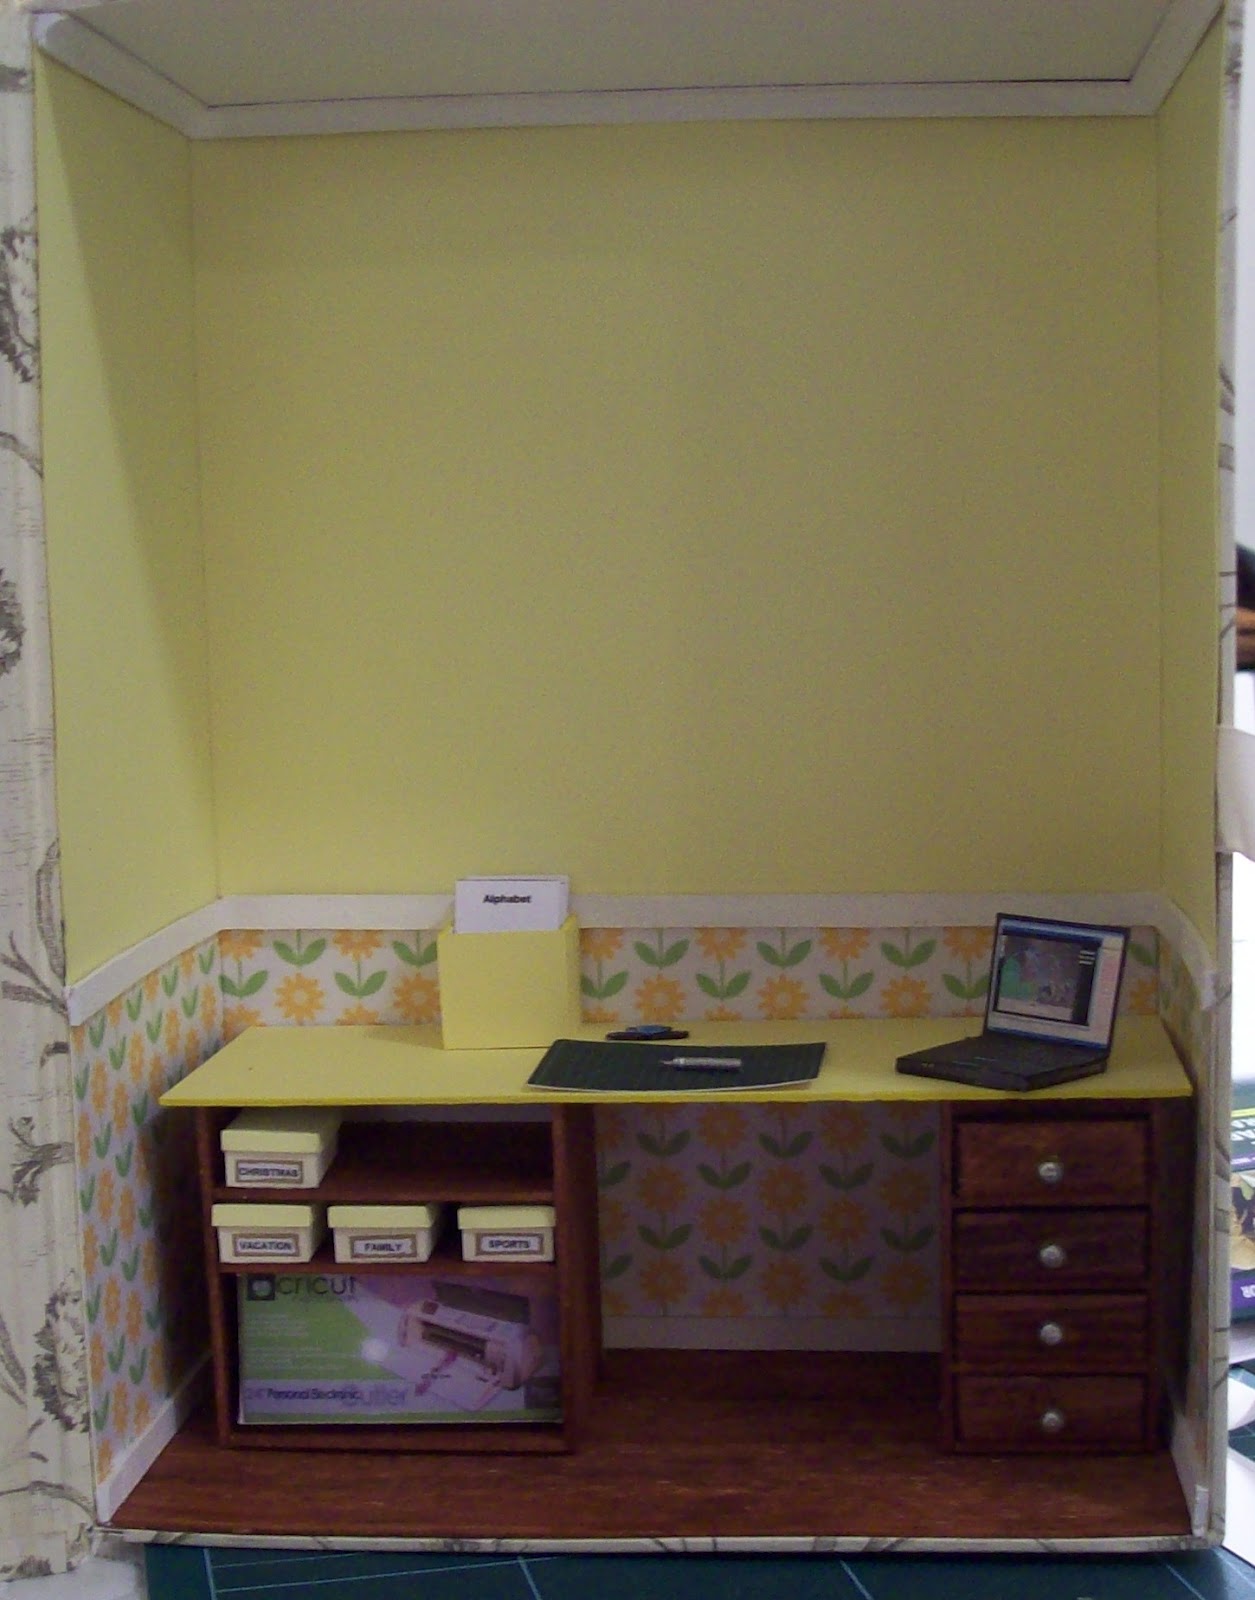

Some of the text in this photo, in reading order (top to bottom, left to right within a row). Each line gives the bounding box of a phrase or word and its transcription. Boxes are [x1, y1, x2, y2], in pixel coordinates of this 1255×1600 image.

[483, 894, 532, 905] Alphabet
[239, 1167, 298, 1177] CHRISTMAS
[239, 1241, 292, 1250] VACATION
[364, 1243, 402, 1252] FAMILY
[488, 1240, 530, 1249] SPORTS
